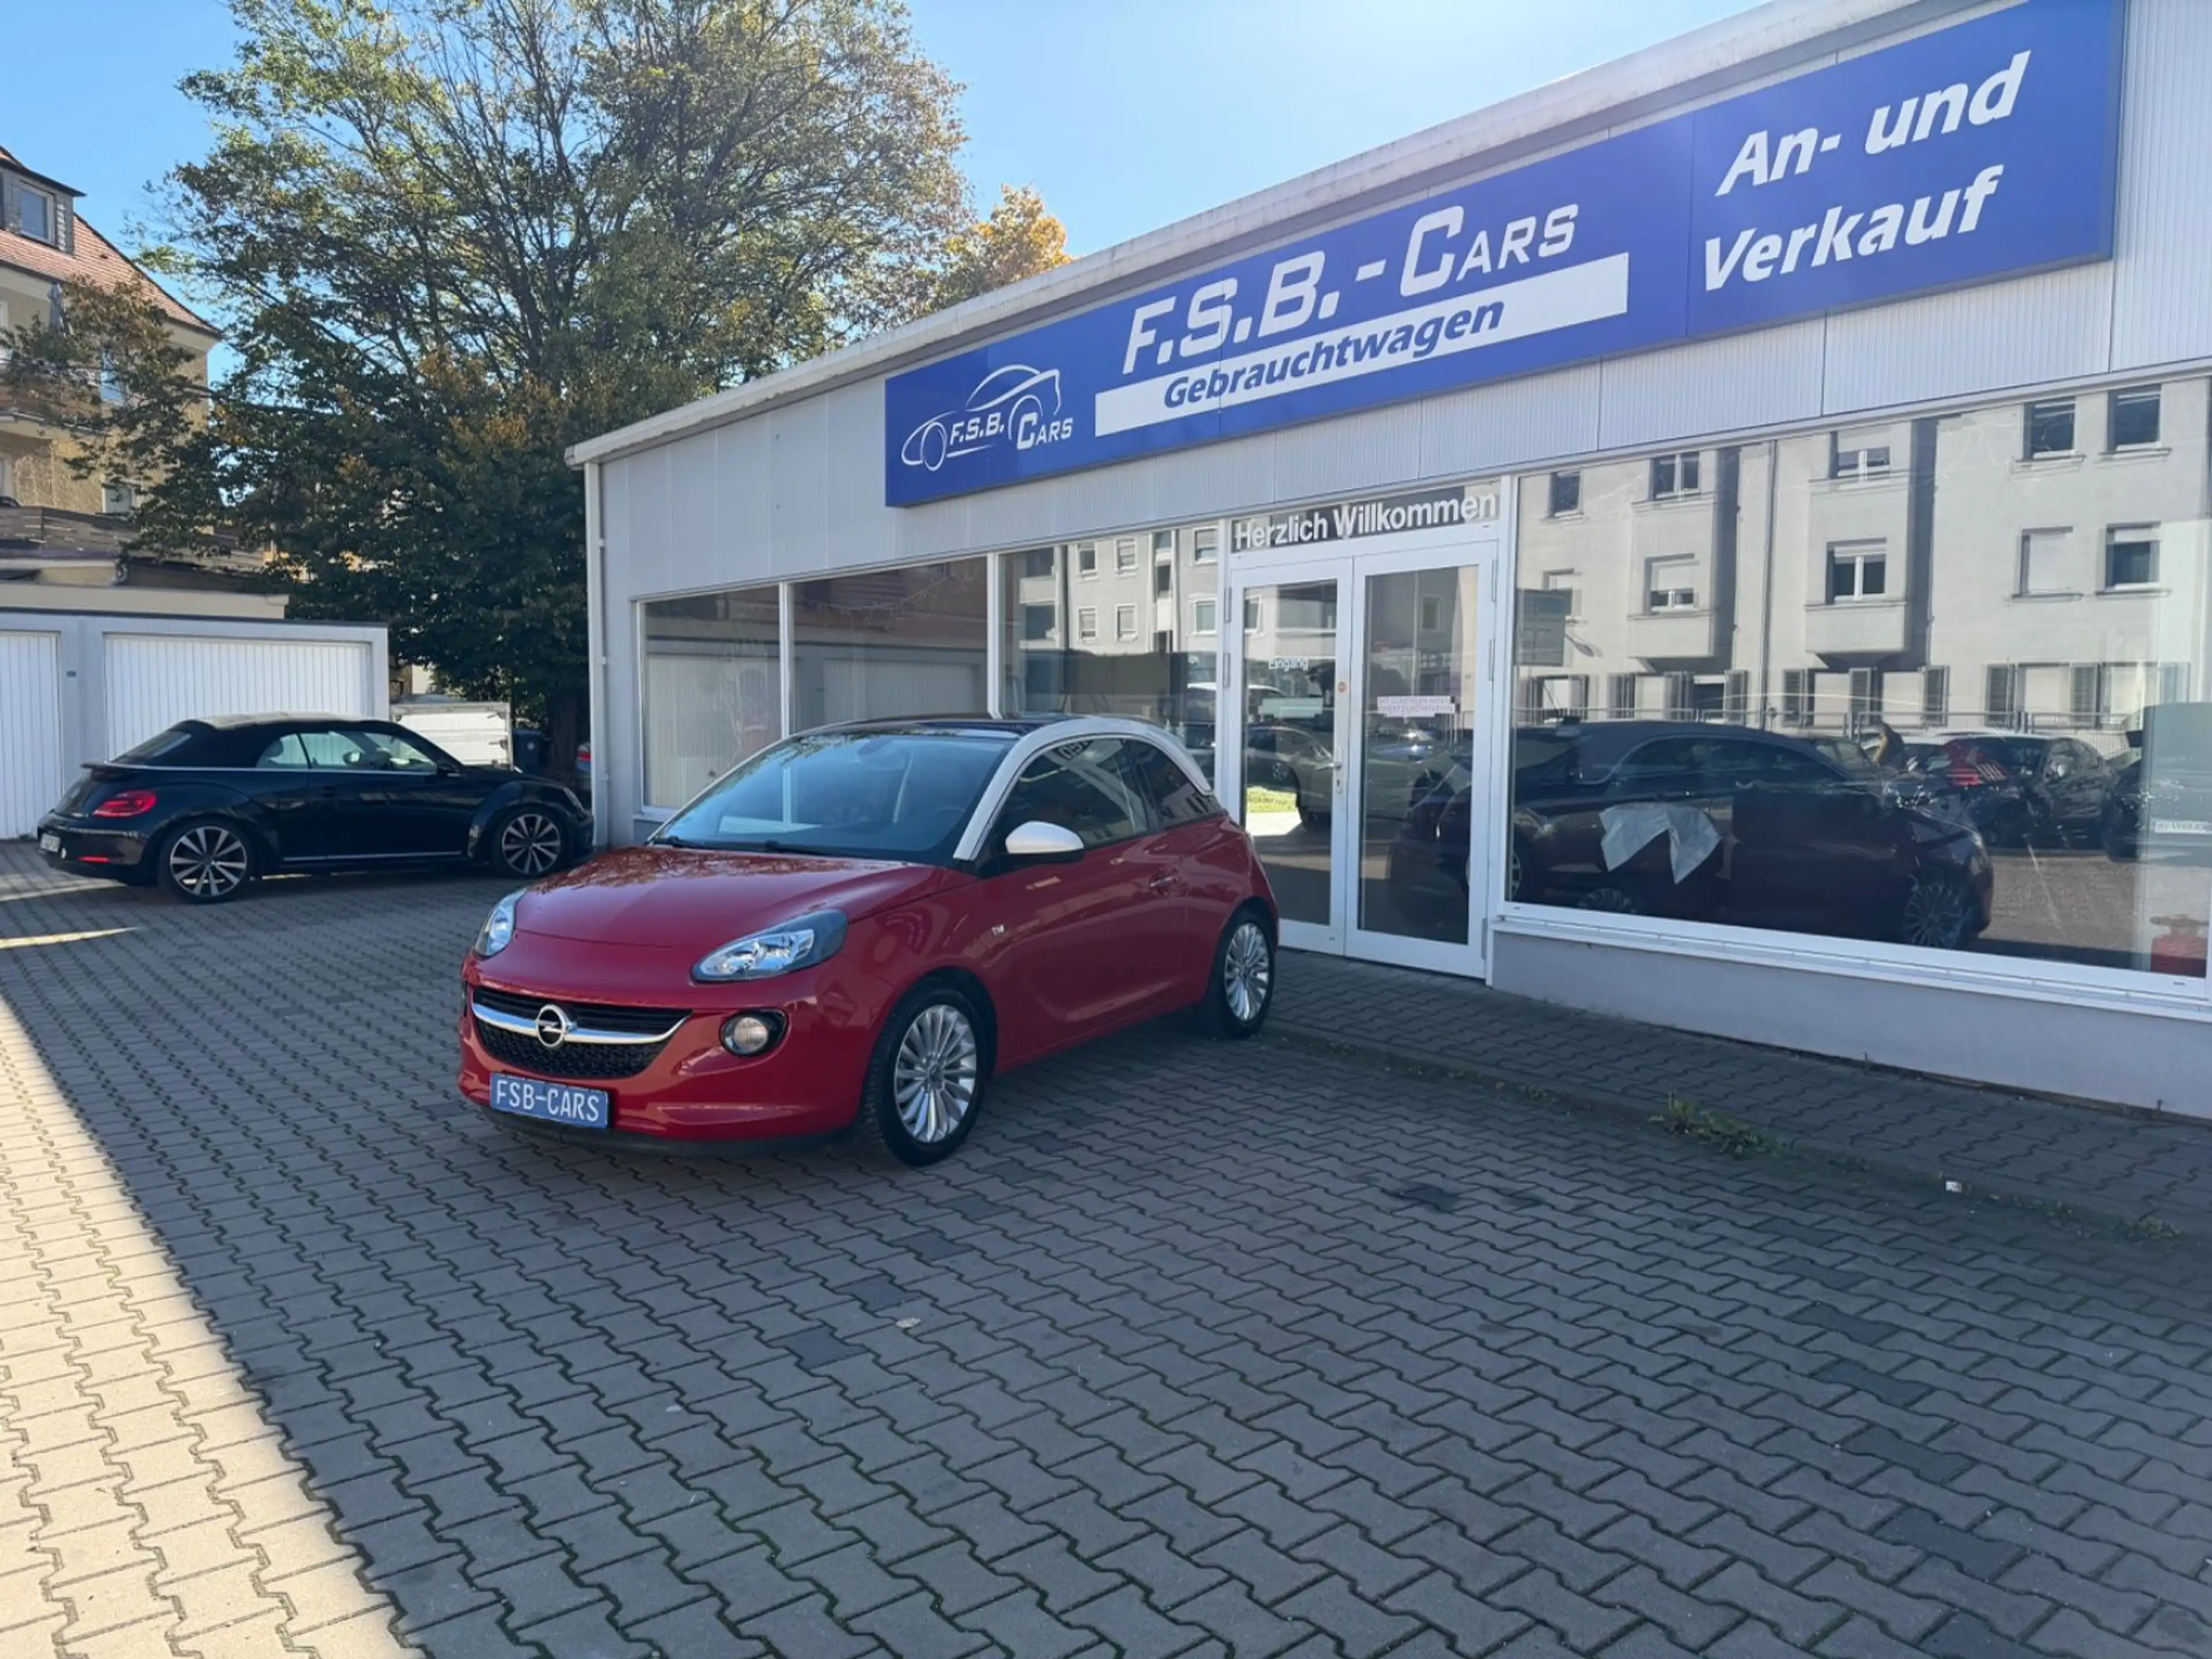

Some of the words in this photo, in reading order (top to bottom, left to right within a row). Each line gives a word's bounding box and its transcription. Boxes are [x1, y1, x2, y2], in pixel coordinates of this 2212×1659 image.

[1715, 127, 1841, 196] An-
[1865, 50, 2031, 154] und
[1705, 164, 2005, 291] Verkauf
[1164, 300, 1505, 408] Gebrauchtwagen
[949, 412, 1005, 446] F.S.B.
[1235, 512, 1327, 550] Herzlich
[1332, 493, 1496, 539] Willkommen
[496, 1080, 599, 1122] FSB-CARS
